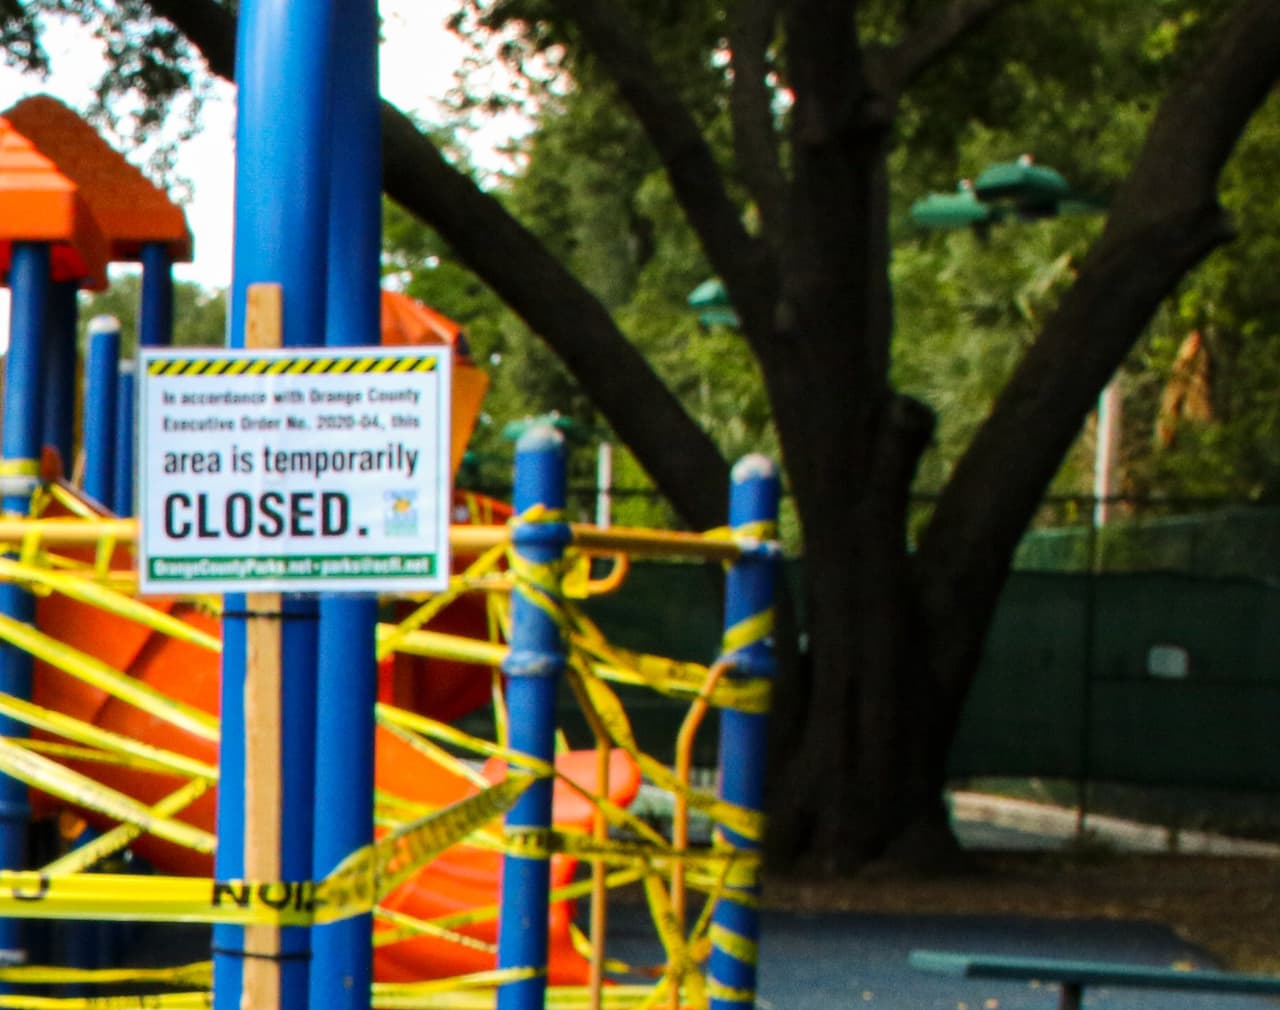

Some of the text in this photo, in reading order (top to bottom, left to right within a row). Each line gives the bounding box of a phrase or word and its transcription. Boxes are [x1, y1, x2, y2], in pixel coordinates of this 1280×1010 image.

[162, 387, 420, 406] In accordance with Orange County
[163, 413, 420, 431] Executive Order No. 2020-04, this
[164, 442, 419, 478] area is temporarily
[163, 491, 369, 540] CLOSED.
